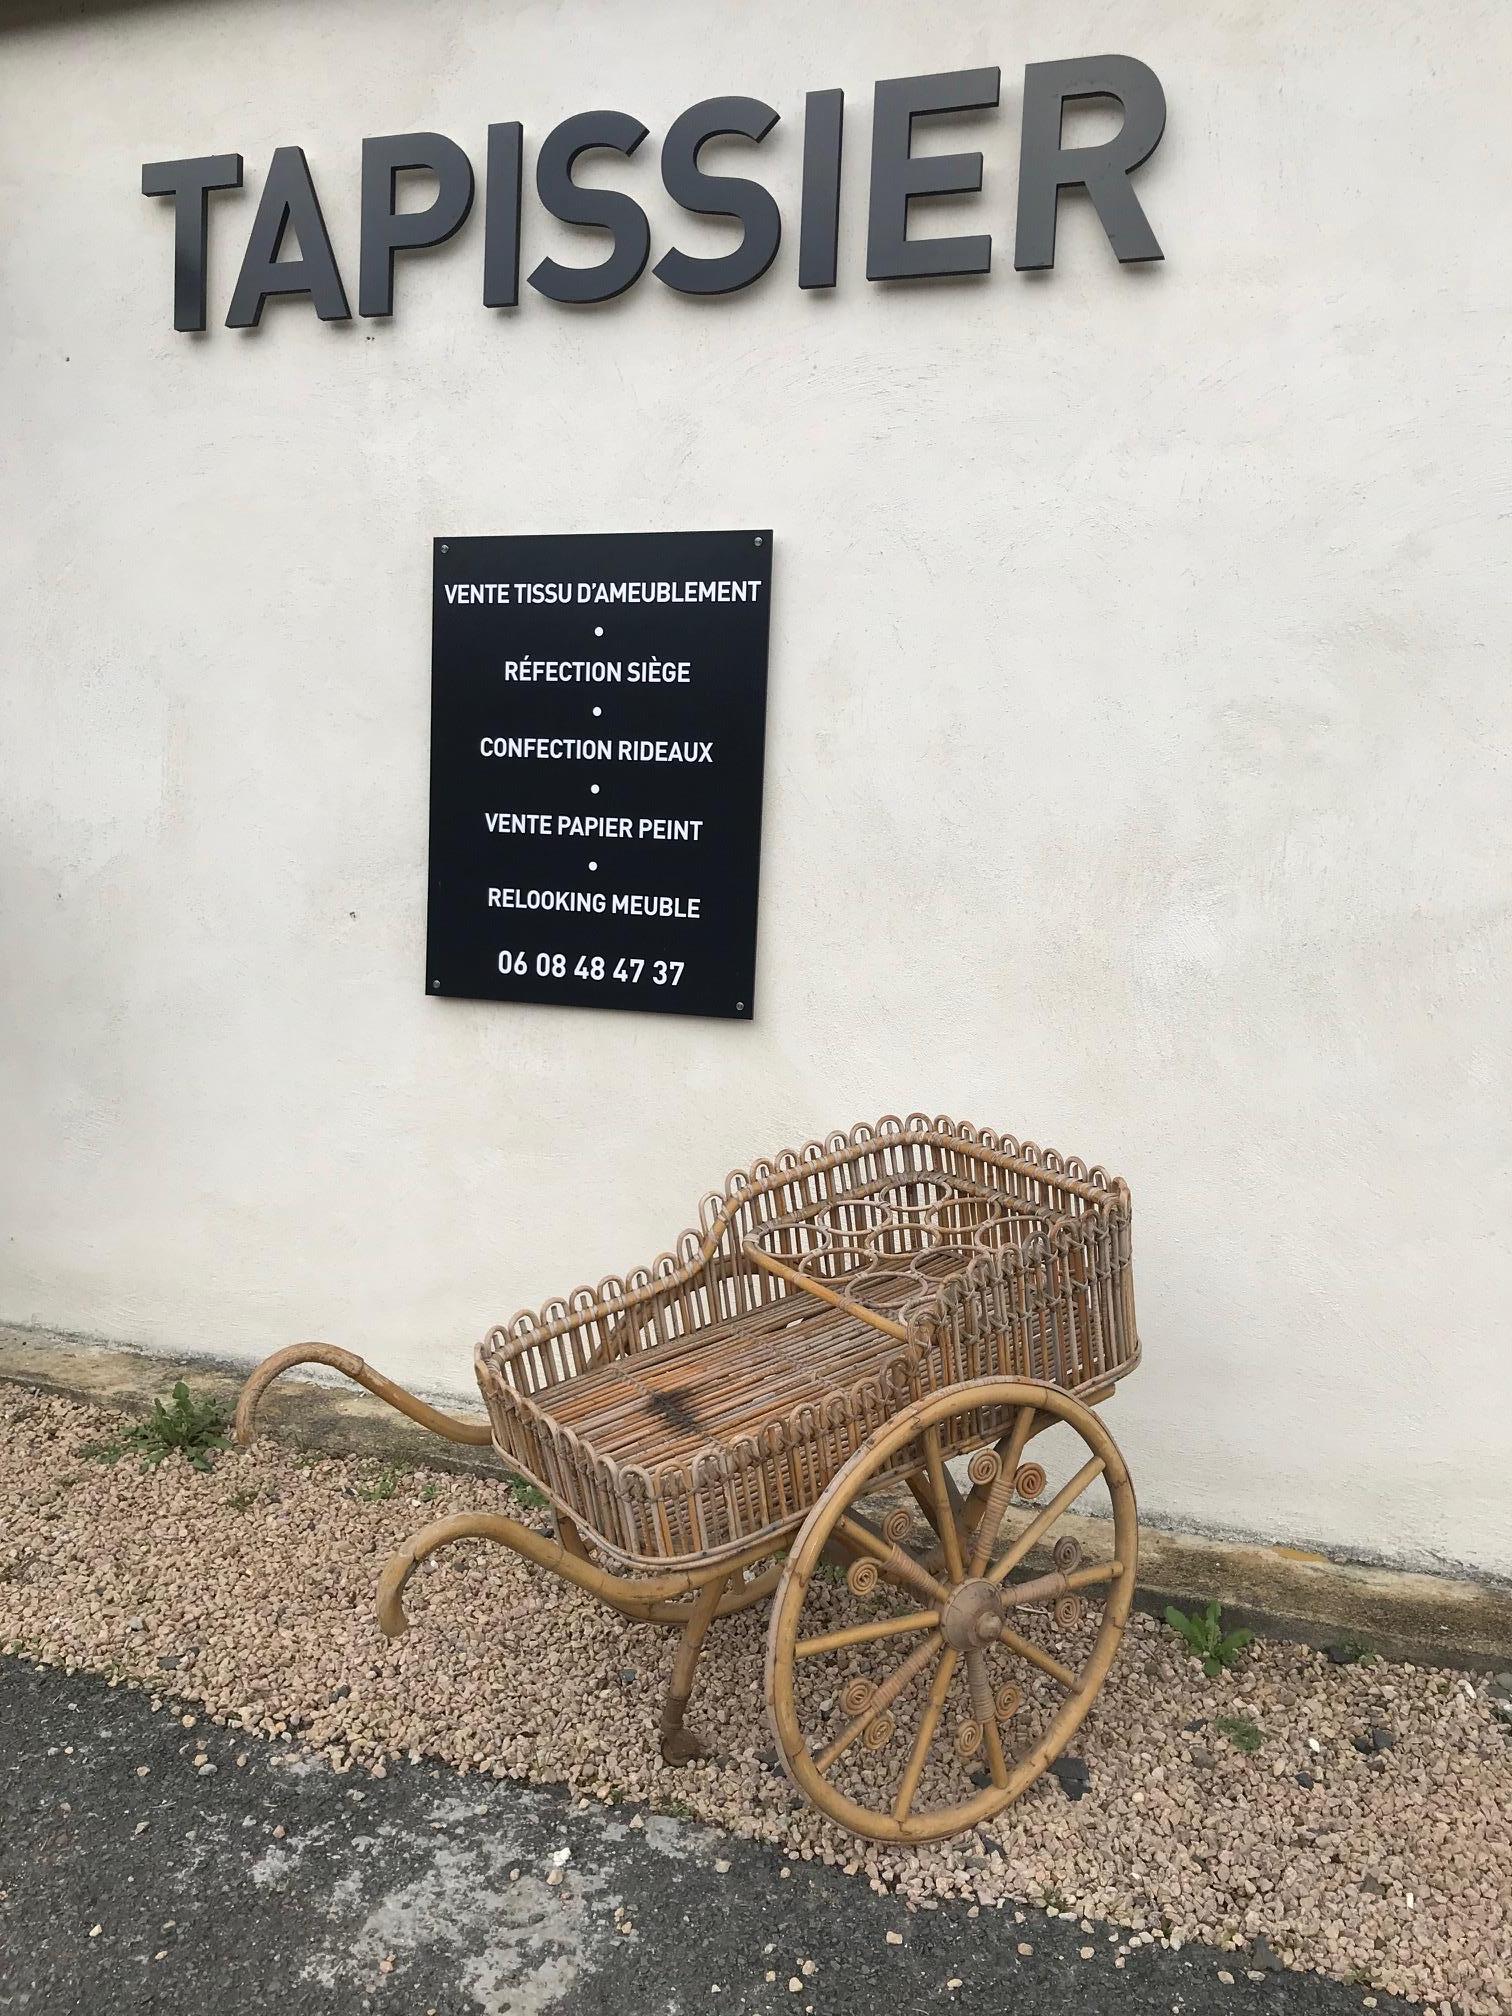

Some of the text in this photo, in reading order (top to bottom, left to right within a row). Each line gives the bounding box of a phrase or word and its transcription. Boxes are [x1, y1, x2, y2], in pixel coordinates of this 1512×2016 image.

[142, 54, 1168, 333] TAPISSIER
[444, 580, 762, 604] VENTE TISSU D'AMEUBLEMENT
[504, 655, 691, 683] RÉFECTION SIÈGE
[480, 736, 714, 763] CONFECTION RIDEAUX
[484, 812, 704, 841] VENTE PAPIER PEINT
[488, 887, 701, 919] RELOOKING MEUBLE
[498, 949, 685, 986] 06 08 48 47 37
